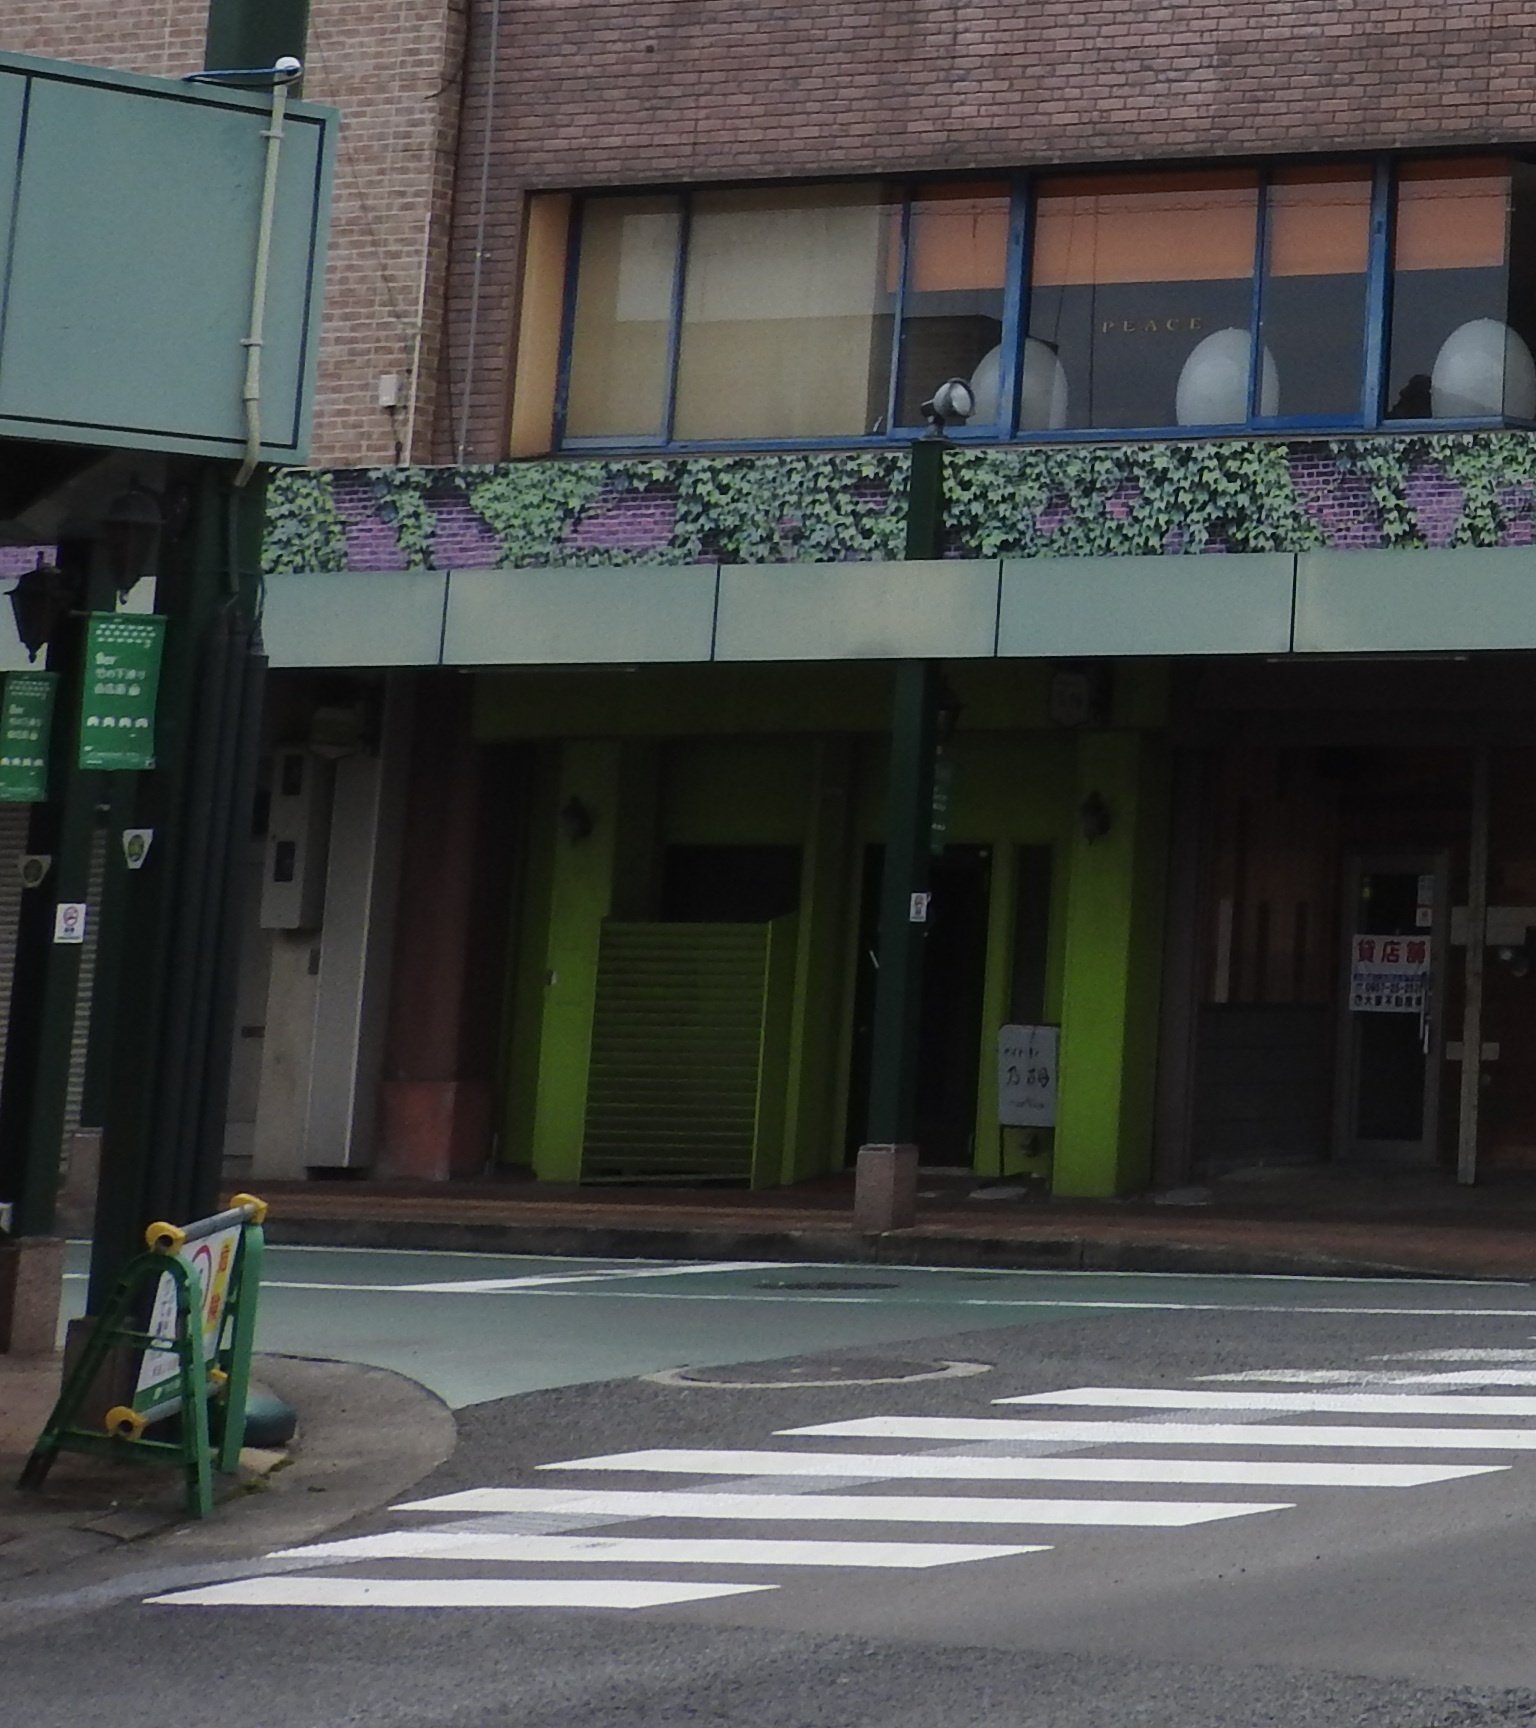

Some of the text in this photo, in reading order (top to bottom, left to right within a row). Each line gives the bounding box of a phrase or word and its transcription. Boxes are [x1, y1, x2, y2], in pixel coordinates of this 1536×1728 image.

[1103, 316, 1204, 334] PEACE
[1358, 939, 1426, 964] 貸店舗
